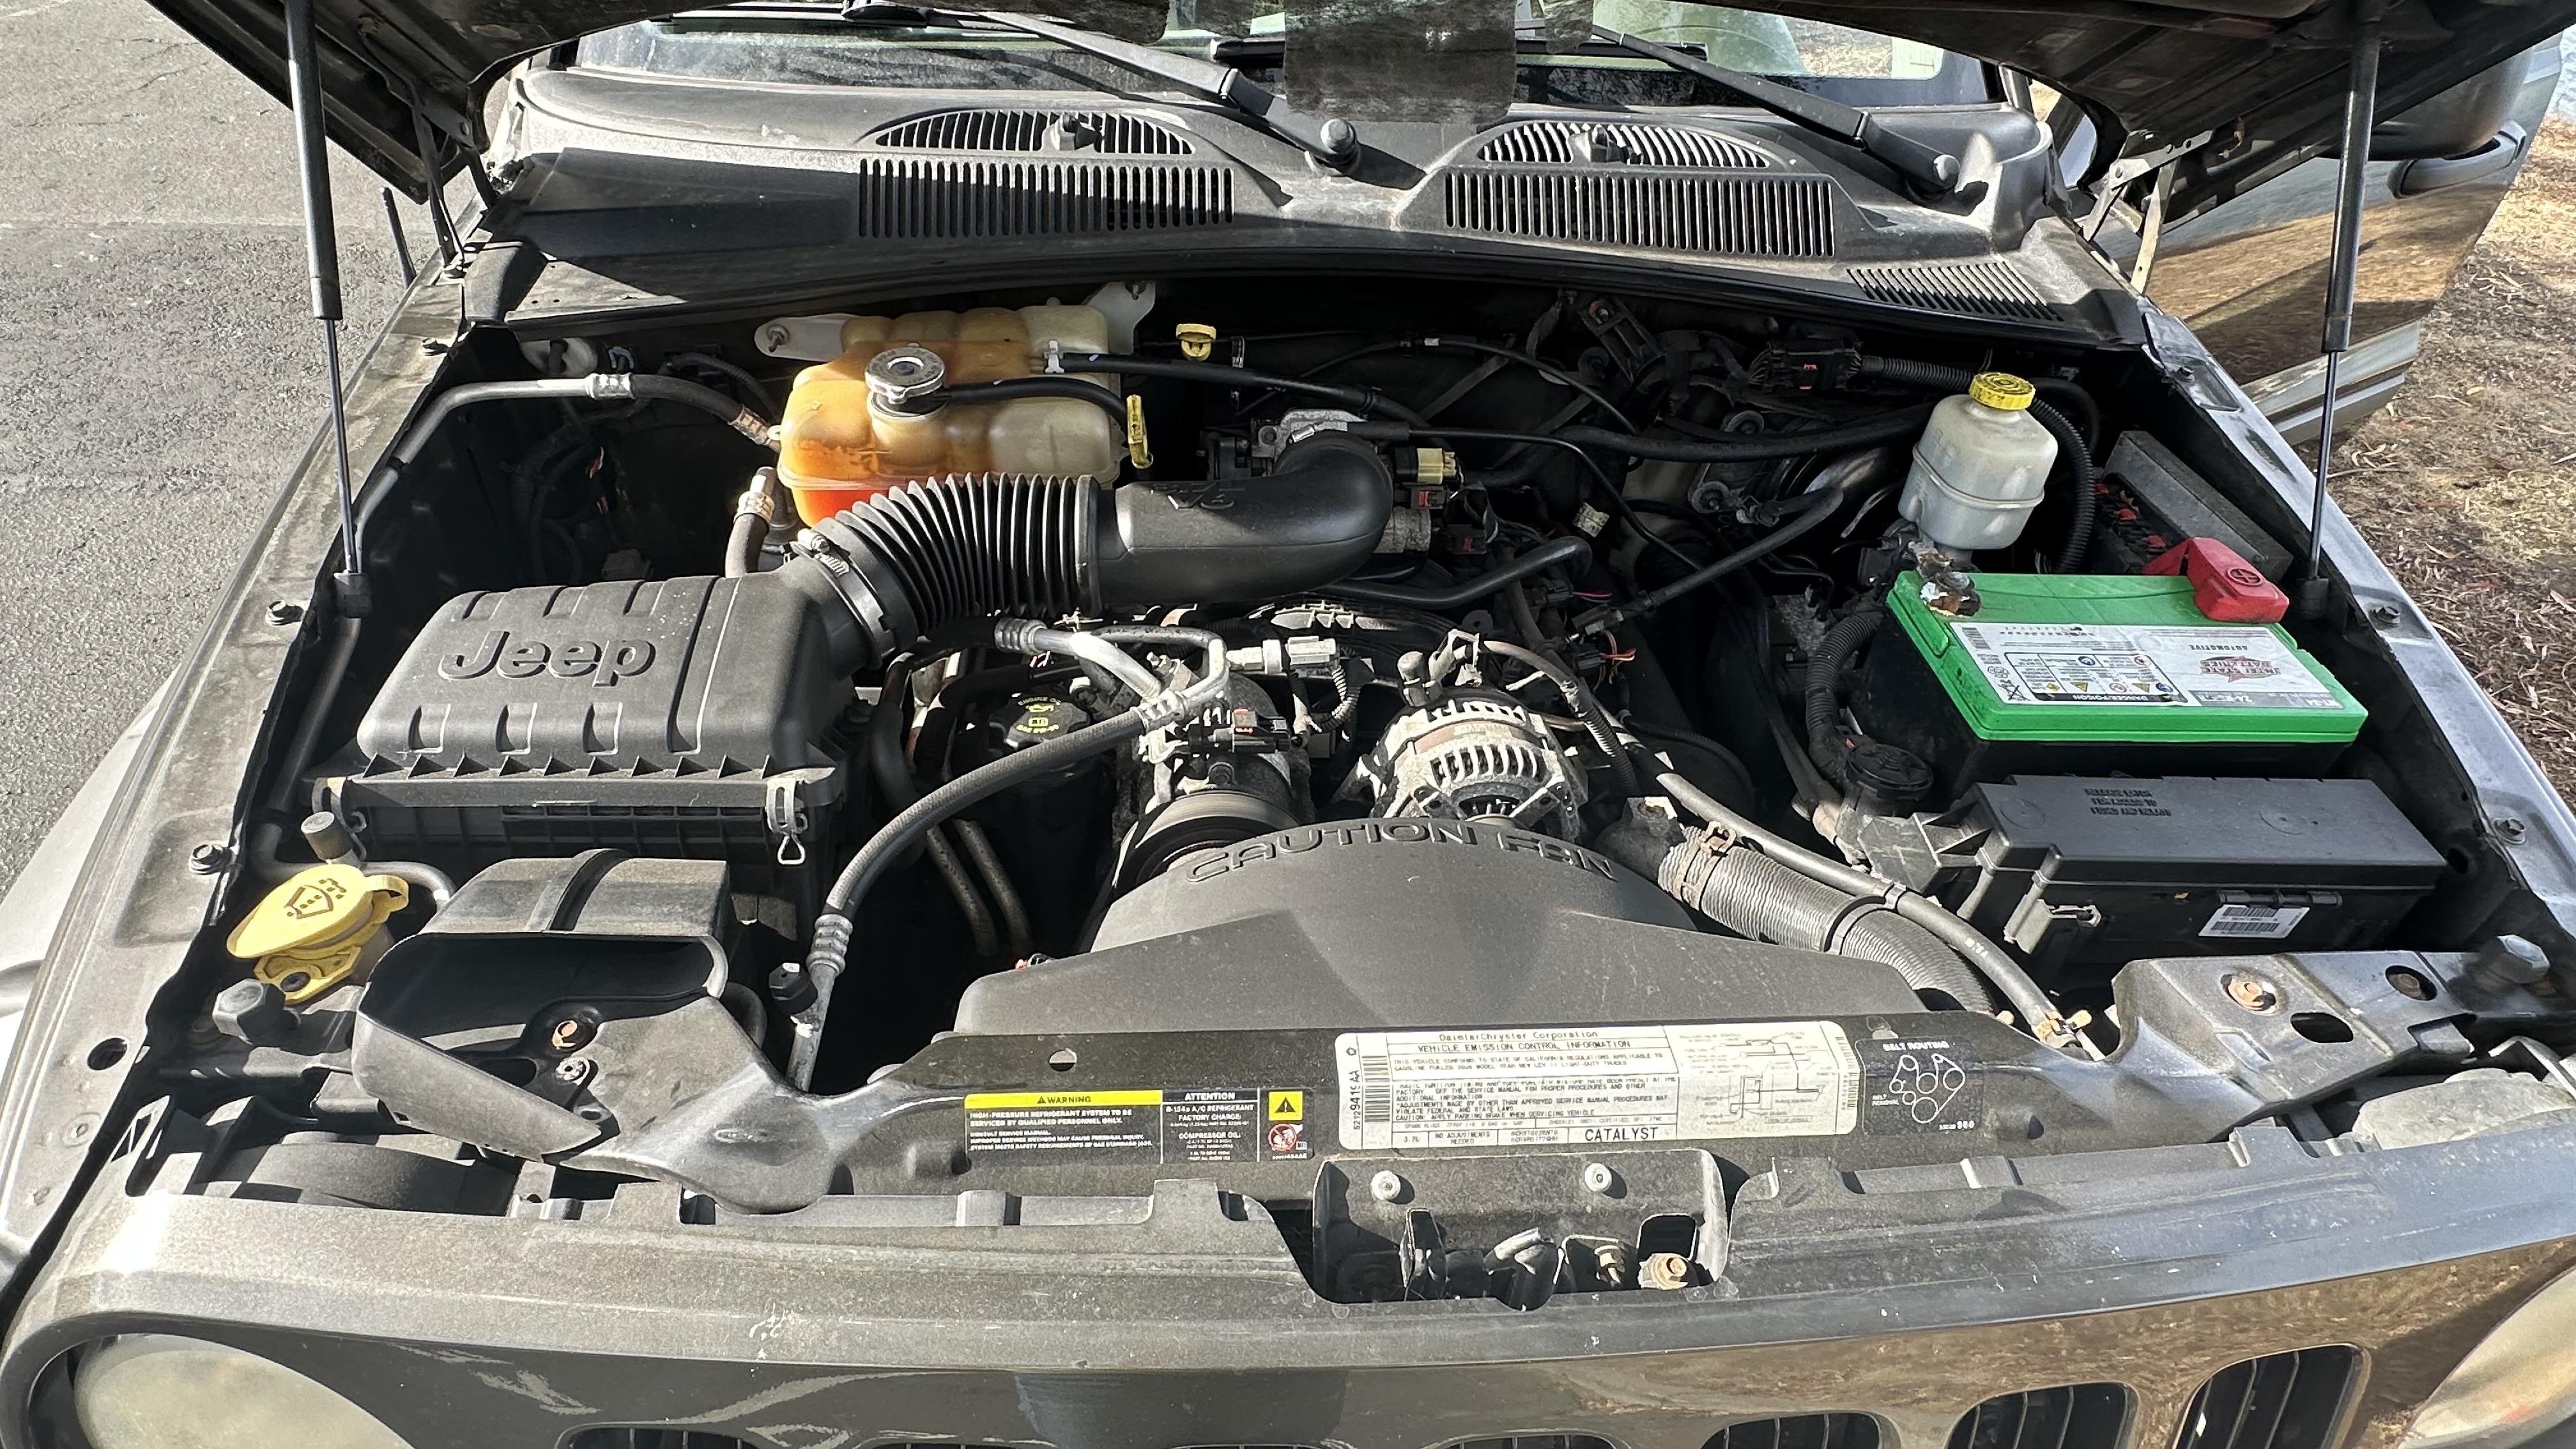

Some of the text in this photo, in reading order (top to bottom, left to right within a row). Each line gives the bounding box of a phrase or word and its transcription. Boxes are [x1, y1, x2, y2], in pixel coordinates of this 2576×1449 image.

[438, 630, 657, 687] Jeep
[2200, 660, 2272, 668] BATTERIES
[2200, 666, 2281, 675] INTERSTATE
[1186, 821, 1619, 884] CAUTION FAN
[1439, 1031, 1598, 1042] DaimlerChrysler Corporation
[1418, 1040, 1630, 1053] VEHICLE EMISSION CONTROL INFORMATION
[1882, 1040, 1950, 1052] BELT ROUTING
[1184, 1092, 1236, 1101] ATTENTION
[1031, 1110, 1081, 1118] REFRIGERANT
[1191, 1105, 1206, 1114] A/C
[1207, 1104, 1255, 1112] REFRIGERANT
[1178, 1131, 1227, 1140] COMPRESSOR
[1584, 1126, 1659, 1143] CATALYST
